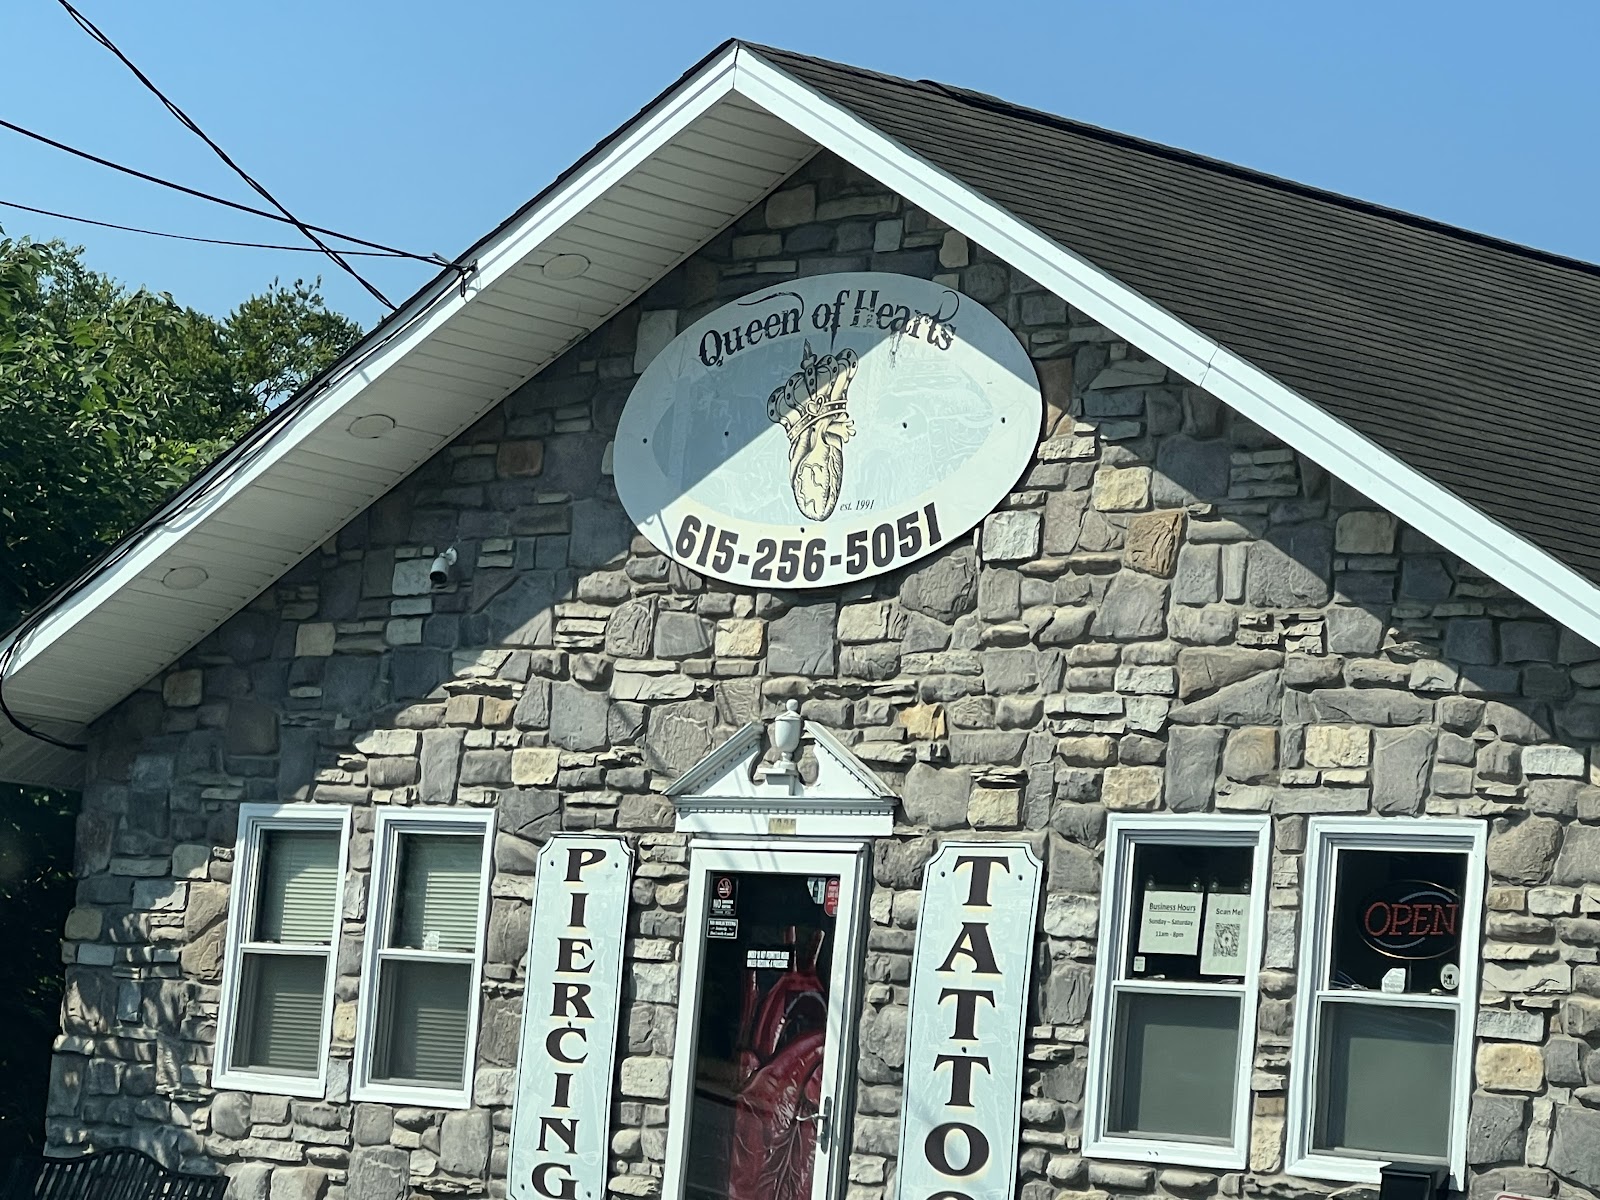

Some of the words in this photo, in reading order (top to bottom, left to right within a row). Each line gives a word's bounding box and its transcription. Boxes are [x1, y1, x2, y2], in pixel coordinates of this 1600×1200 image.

[699, 291, 805, 367] Queen
[811, 290, 850, 340] of
[850, 290, 960, 353] Hearts
[839, 502, 852, 511] est.
[855, 499, 875, 511] 1991
[675, 501, 942, 583] 615-256-5051
[1148, 918, 1167, 926] Sunday
[1171, 918, 1194, 926] Saturday
[1149, 902, 1176, 912] Business
[1177, 903, 1196, 912] Hours
[1215, 908, 1231, 916] Scan
[1364, 901, 1459, 937] OPEN
[531, 847, 606, 1200] PIERCING
[924, 855, 1011, 1200] TATTO
